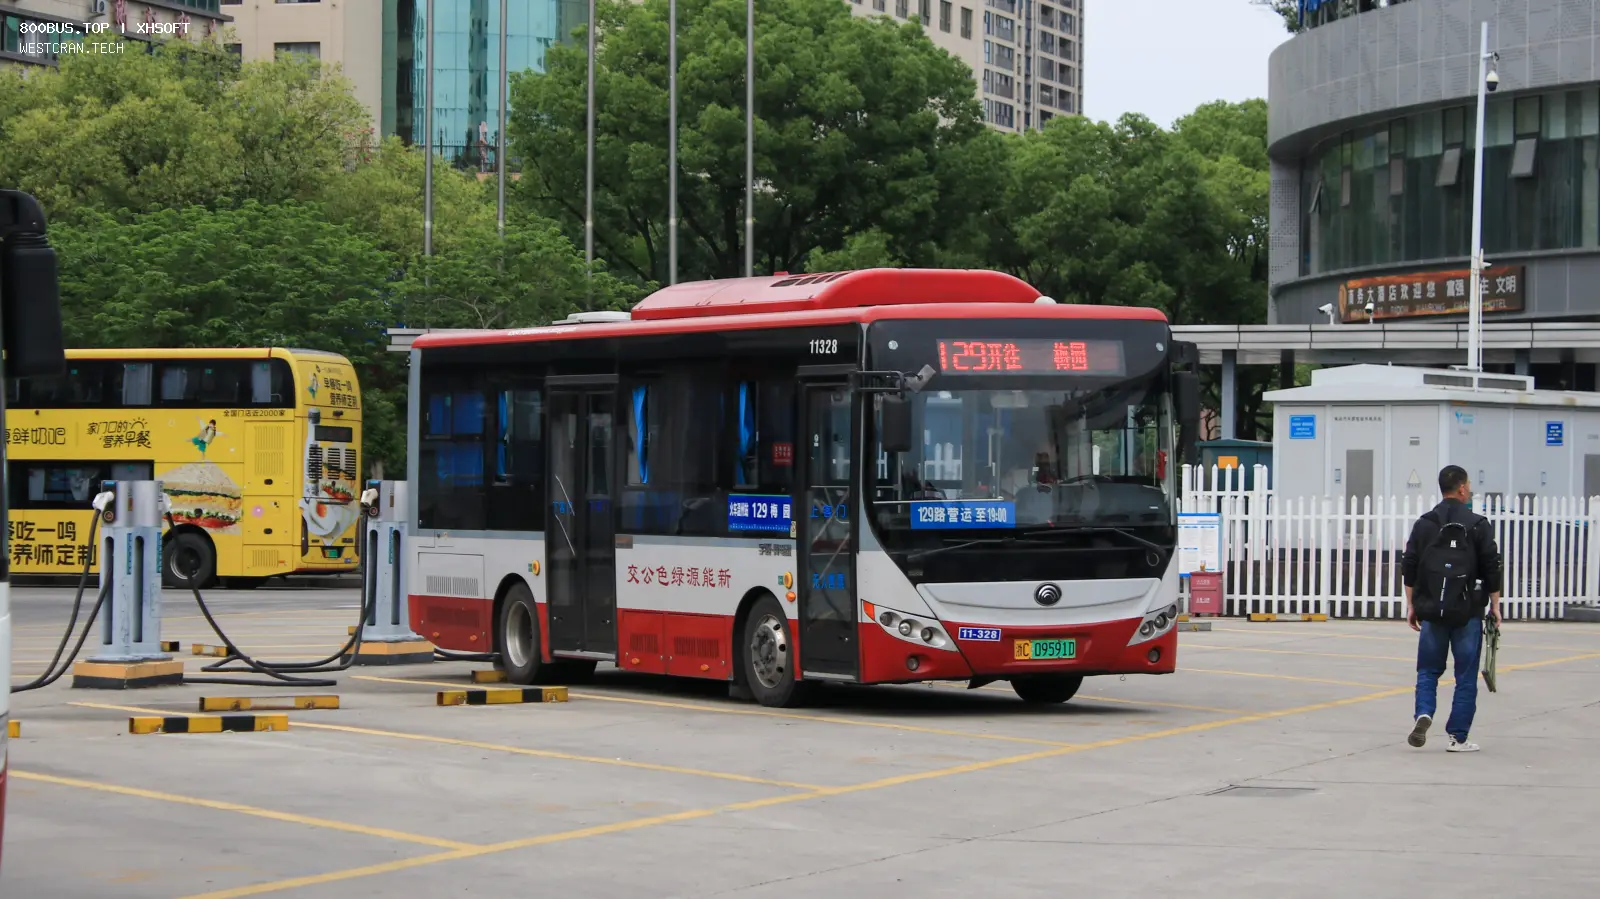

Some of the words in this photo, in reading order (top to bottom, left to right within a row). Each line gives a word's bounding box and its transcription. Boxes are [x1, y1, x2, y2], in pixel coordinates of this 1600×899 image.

[1495, 275, 1516, 294] 文明
[809, 338, 838, 354] 11328
[752, 502, 768, 519] 129
[8, 544, 97, 566] 养师定制
[962, 629, 998, 640] 11-328
